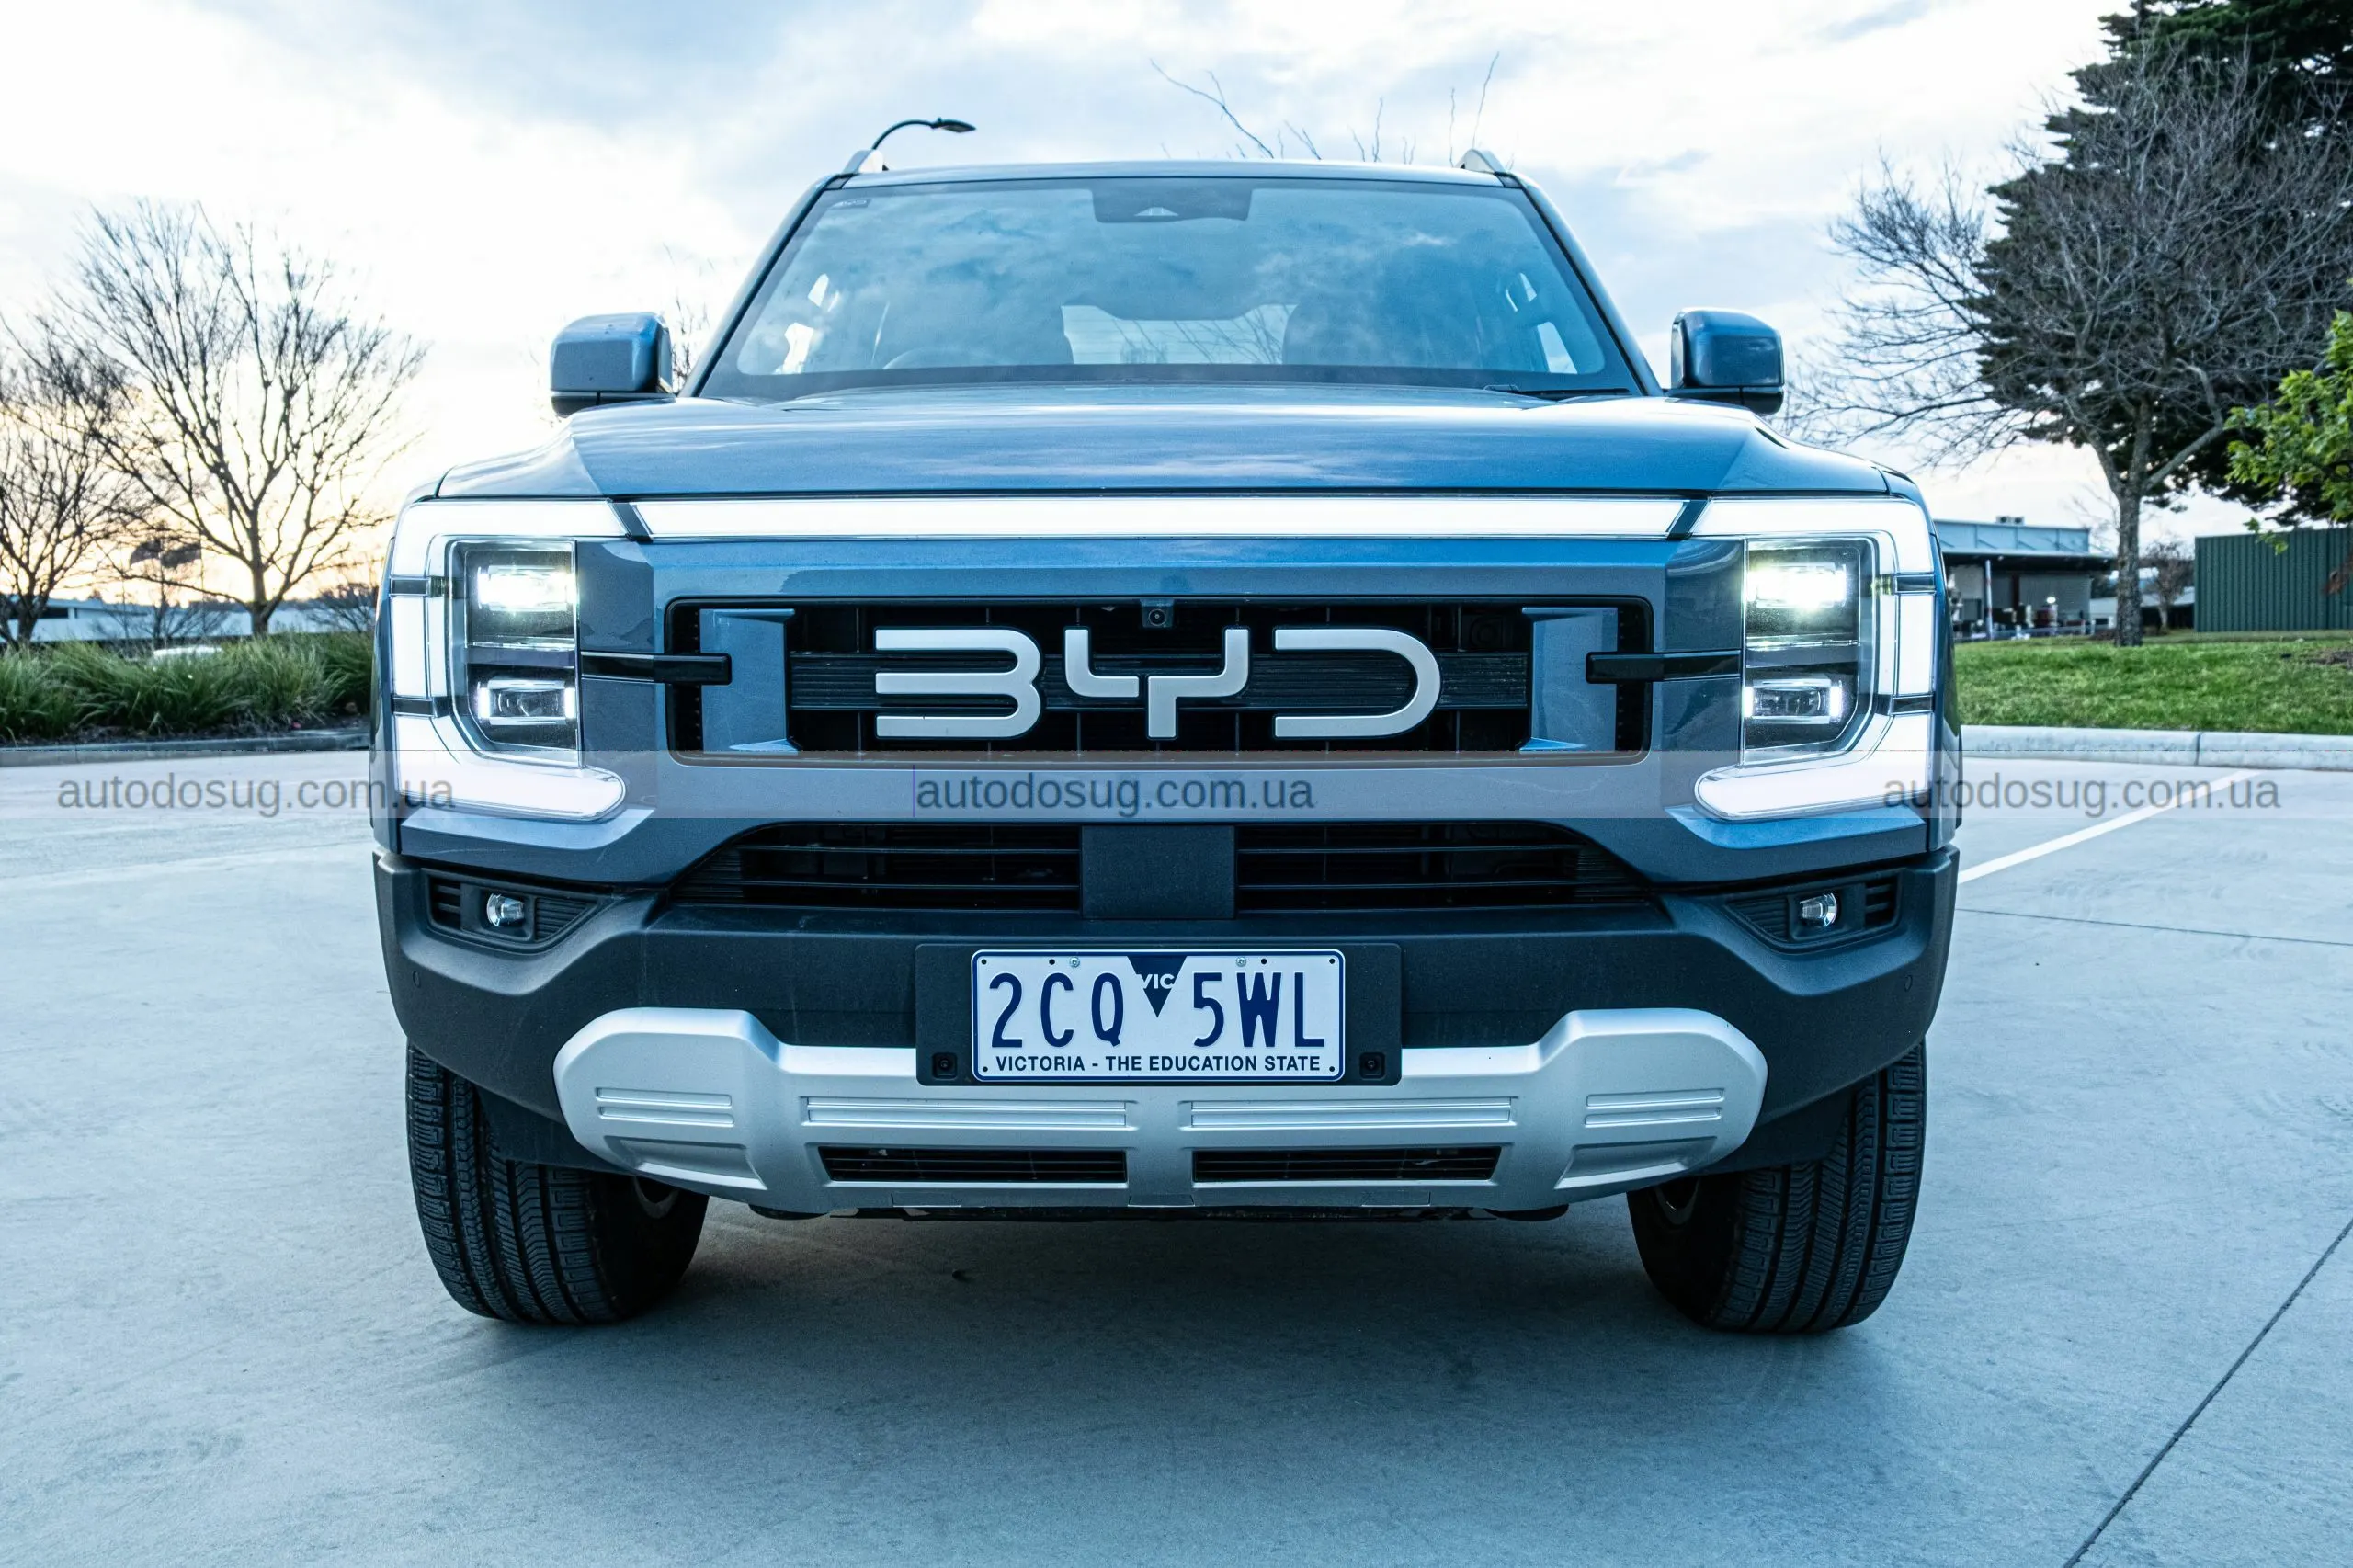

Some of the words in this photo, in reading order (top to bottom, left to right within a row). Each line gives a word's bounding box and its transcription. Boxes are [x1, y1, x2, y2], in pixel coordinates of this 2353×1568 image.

[875, 628, 1441, 739] BYD
[1139, 973, 1175, 989] VIC
[995, 1055, 1085, 1072] VICTORIA
[1105, 1055, 1142, 1071] THE
[1149, 1055, 1258, 1072] EDUCATION
[1264, 1055, 1321, 1072] STATE
